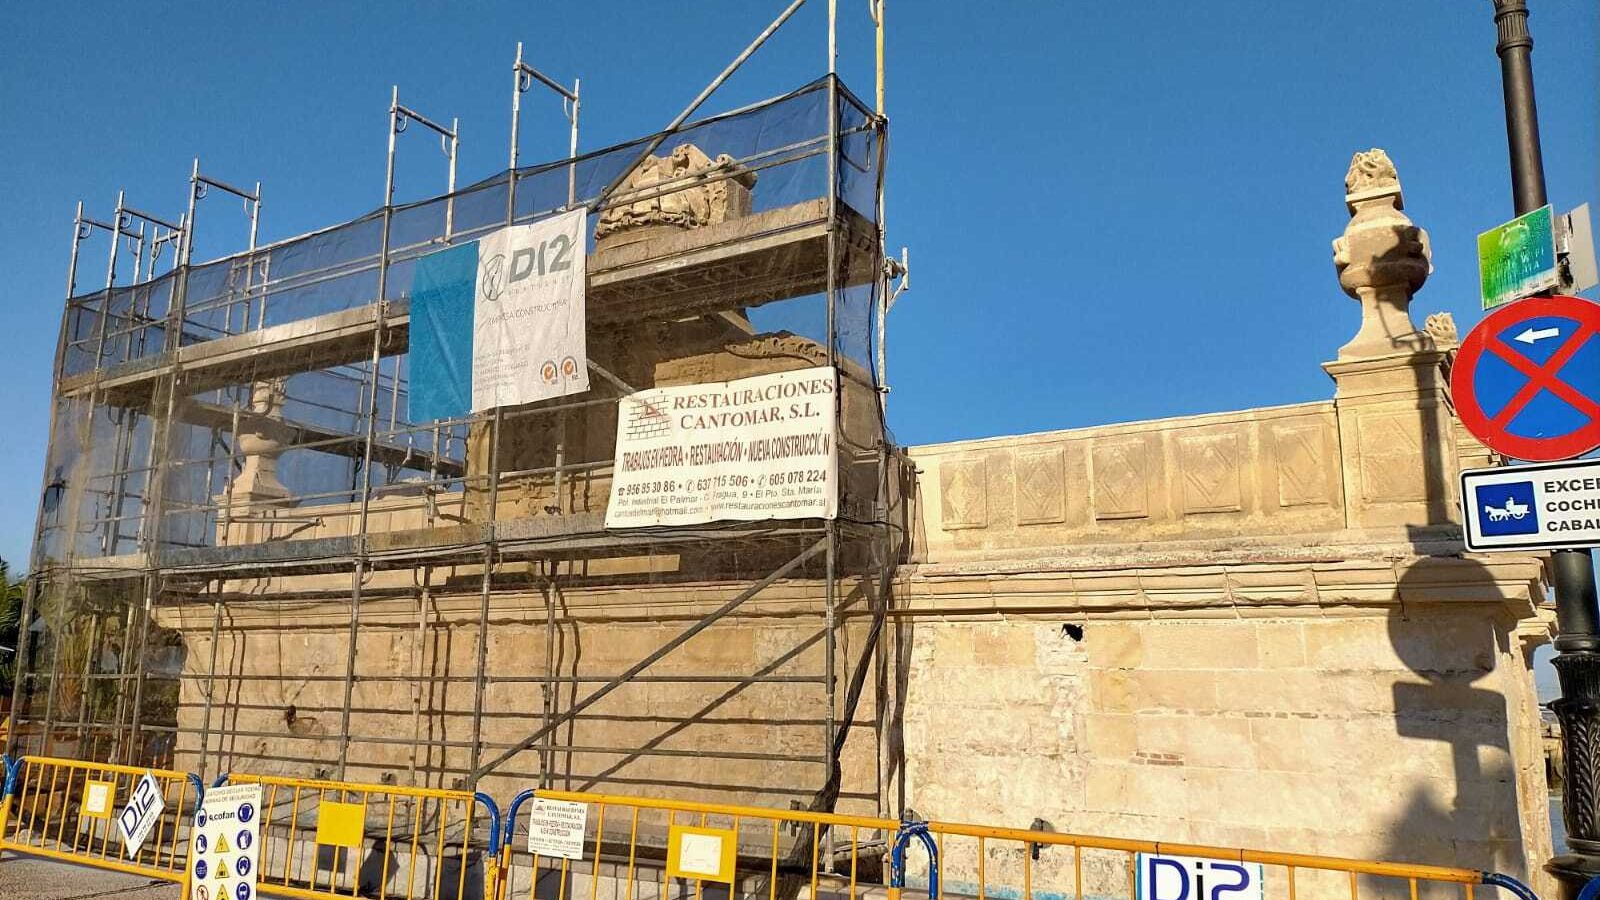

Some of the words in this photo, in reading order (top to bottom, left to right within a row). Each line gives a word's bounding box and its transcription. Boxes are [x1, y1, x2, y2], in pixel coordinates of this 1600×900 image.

[509, 233, 571, 283] DI2
[673, 378, 833, 410] RESTAURACIONES
[680, 406, 785, 430] CANTOMAR,
[789, 402, 820, 419] S.L.
[748, 438, 771, 462] NUEVA
[626, 484, 641, 496] 956
[663, 480, 676, 493] 86
[697, 478, 712, 491] 637
[729, 475, 748, 487] 506
[769, 473, 785, 486] 605
[788, 471, 803, 484] 078
[807, 470, 826, 482] 224
[1546, 499, 1600, 512] COCH
